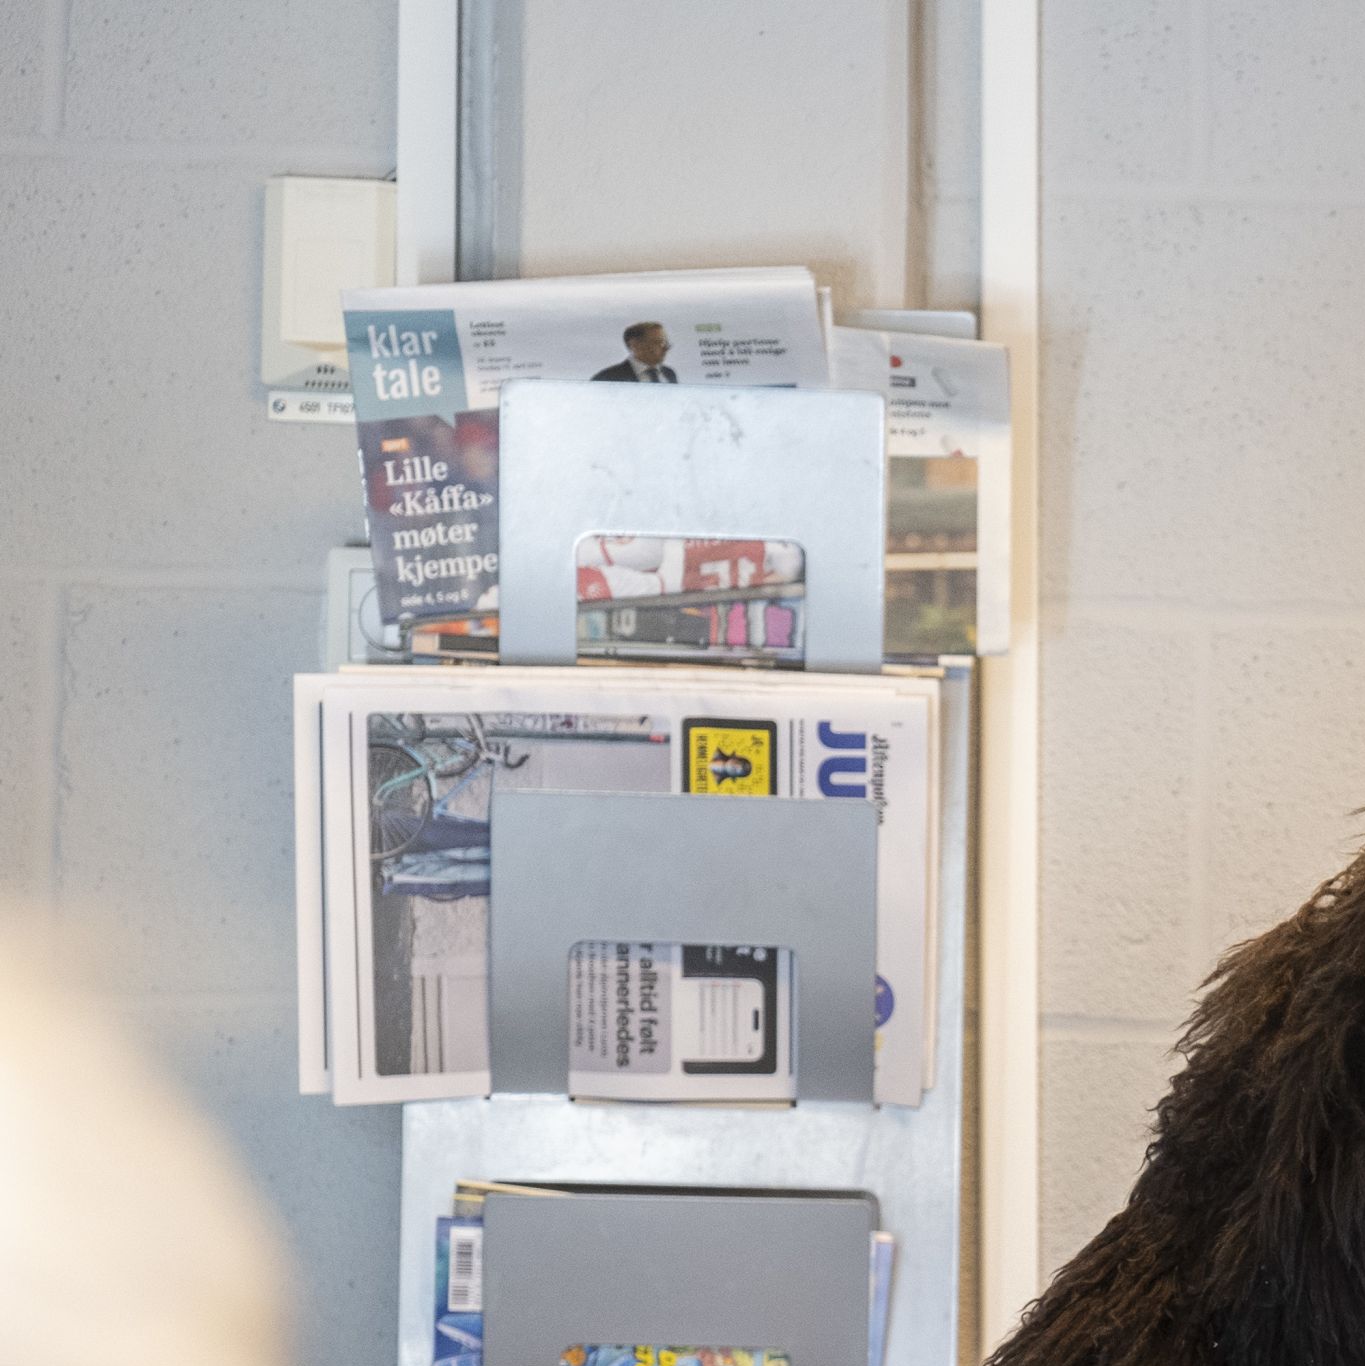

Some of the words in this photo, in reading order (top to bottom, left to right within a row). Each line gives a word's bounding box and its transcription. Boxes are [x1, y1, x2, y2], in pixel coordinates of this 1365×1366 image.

[368, 324, 438, 359] klar
[372, 359, 442, 401] tale
[384, 456, 449, 486] Lille
[389, 483, 495, 517] «Kåffa»
[392, 521, 479, 550] møter
[639, 957, 658, 1015] alltid
[616, 942, 635, 1069] annerledes
[639, 1017, 658, 1055] følt
